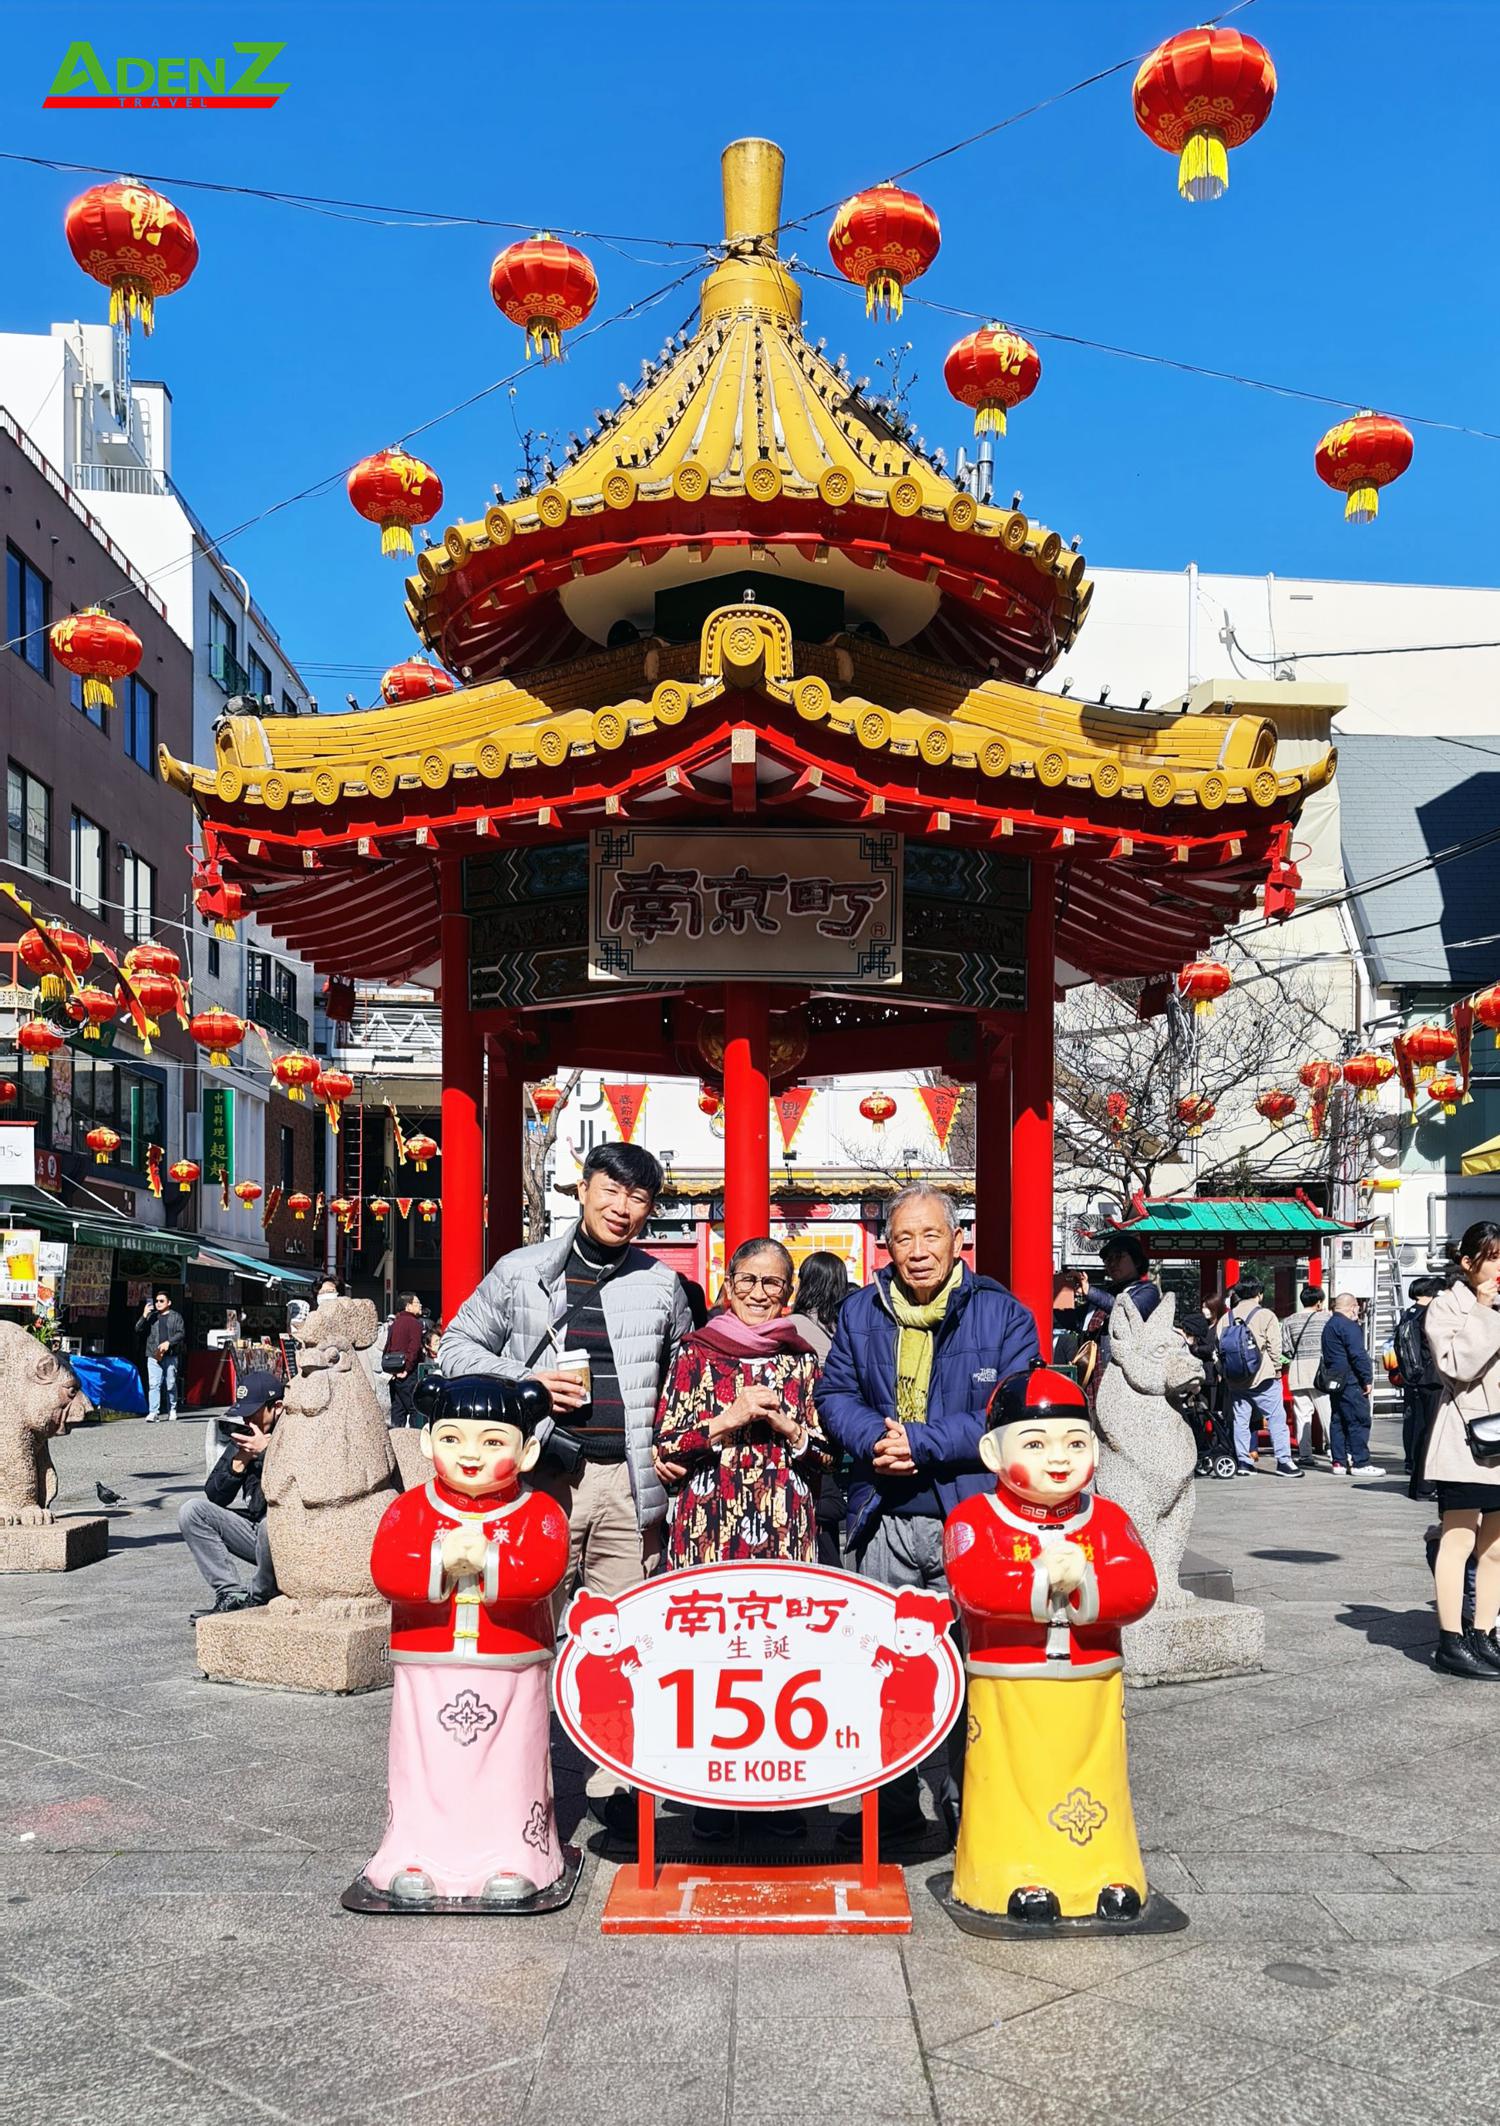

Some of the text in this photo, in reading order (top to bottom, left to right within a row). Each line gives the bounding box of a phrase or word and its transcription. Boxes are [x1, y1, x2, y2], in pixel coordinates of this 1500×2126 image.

[607, 862, 888, 943] 南京町
[212, 1092, 224, 1136] 中国料理
[664, 1589, 849, 1638] 南京町
[727, 1634, 791, 1660] 生誕
[708, 1760, 807, 1783] BE KOBE
